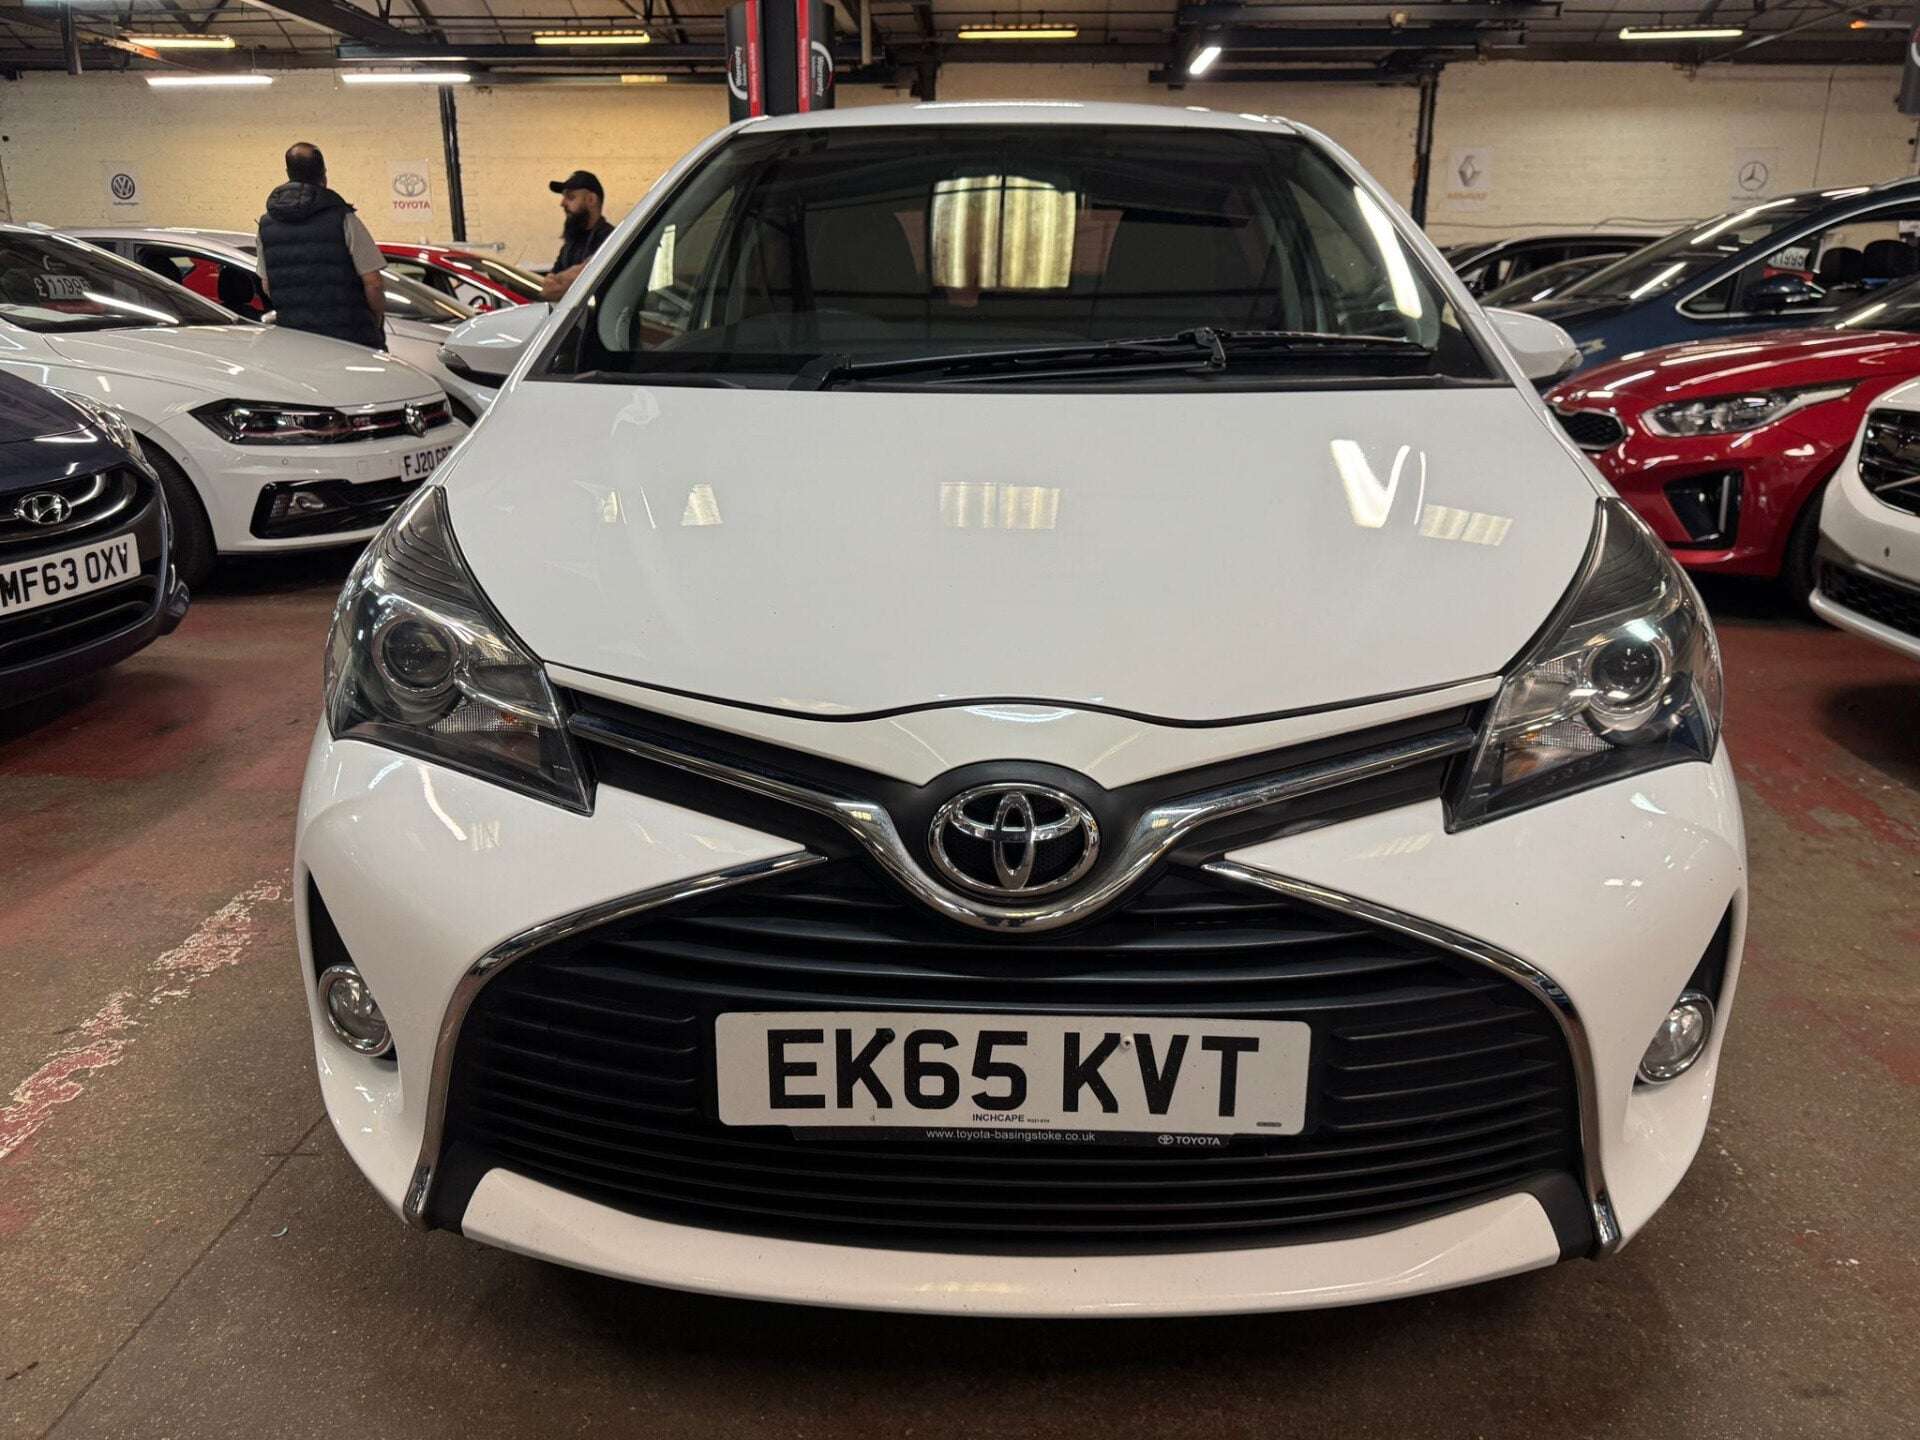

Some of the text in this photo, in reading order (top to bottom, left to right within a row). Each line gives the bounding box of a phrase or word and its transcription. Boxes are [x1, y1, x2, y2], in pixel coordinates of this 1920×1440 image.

[393, 200, 430, 209] TOYOTA
[403, 450, 435, 476] FJ20
[0, 542, 127, 607] MF63 OXV
[767, 1028, 1260, 1117] EK65 KVT
[972, 1112, 1025, 1122] INCHCAPE
[926, 1128, 1096, 1142] www.toyota-basingstoke.co.uk
[1175, 1135, 1221, 1146] TOYOTA
